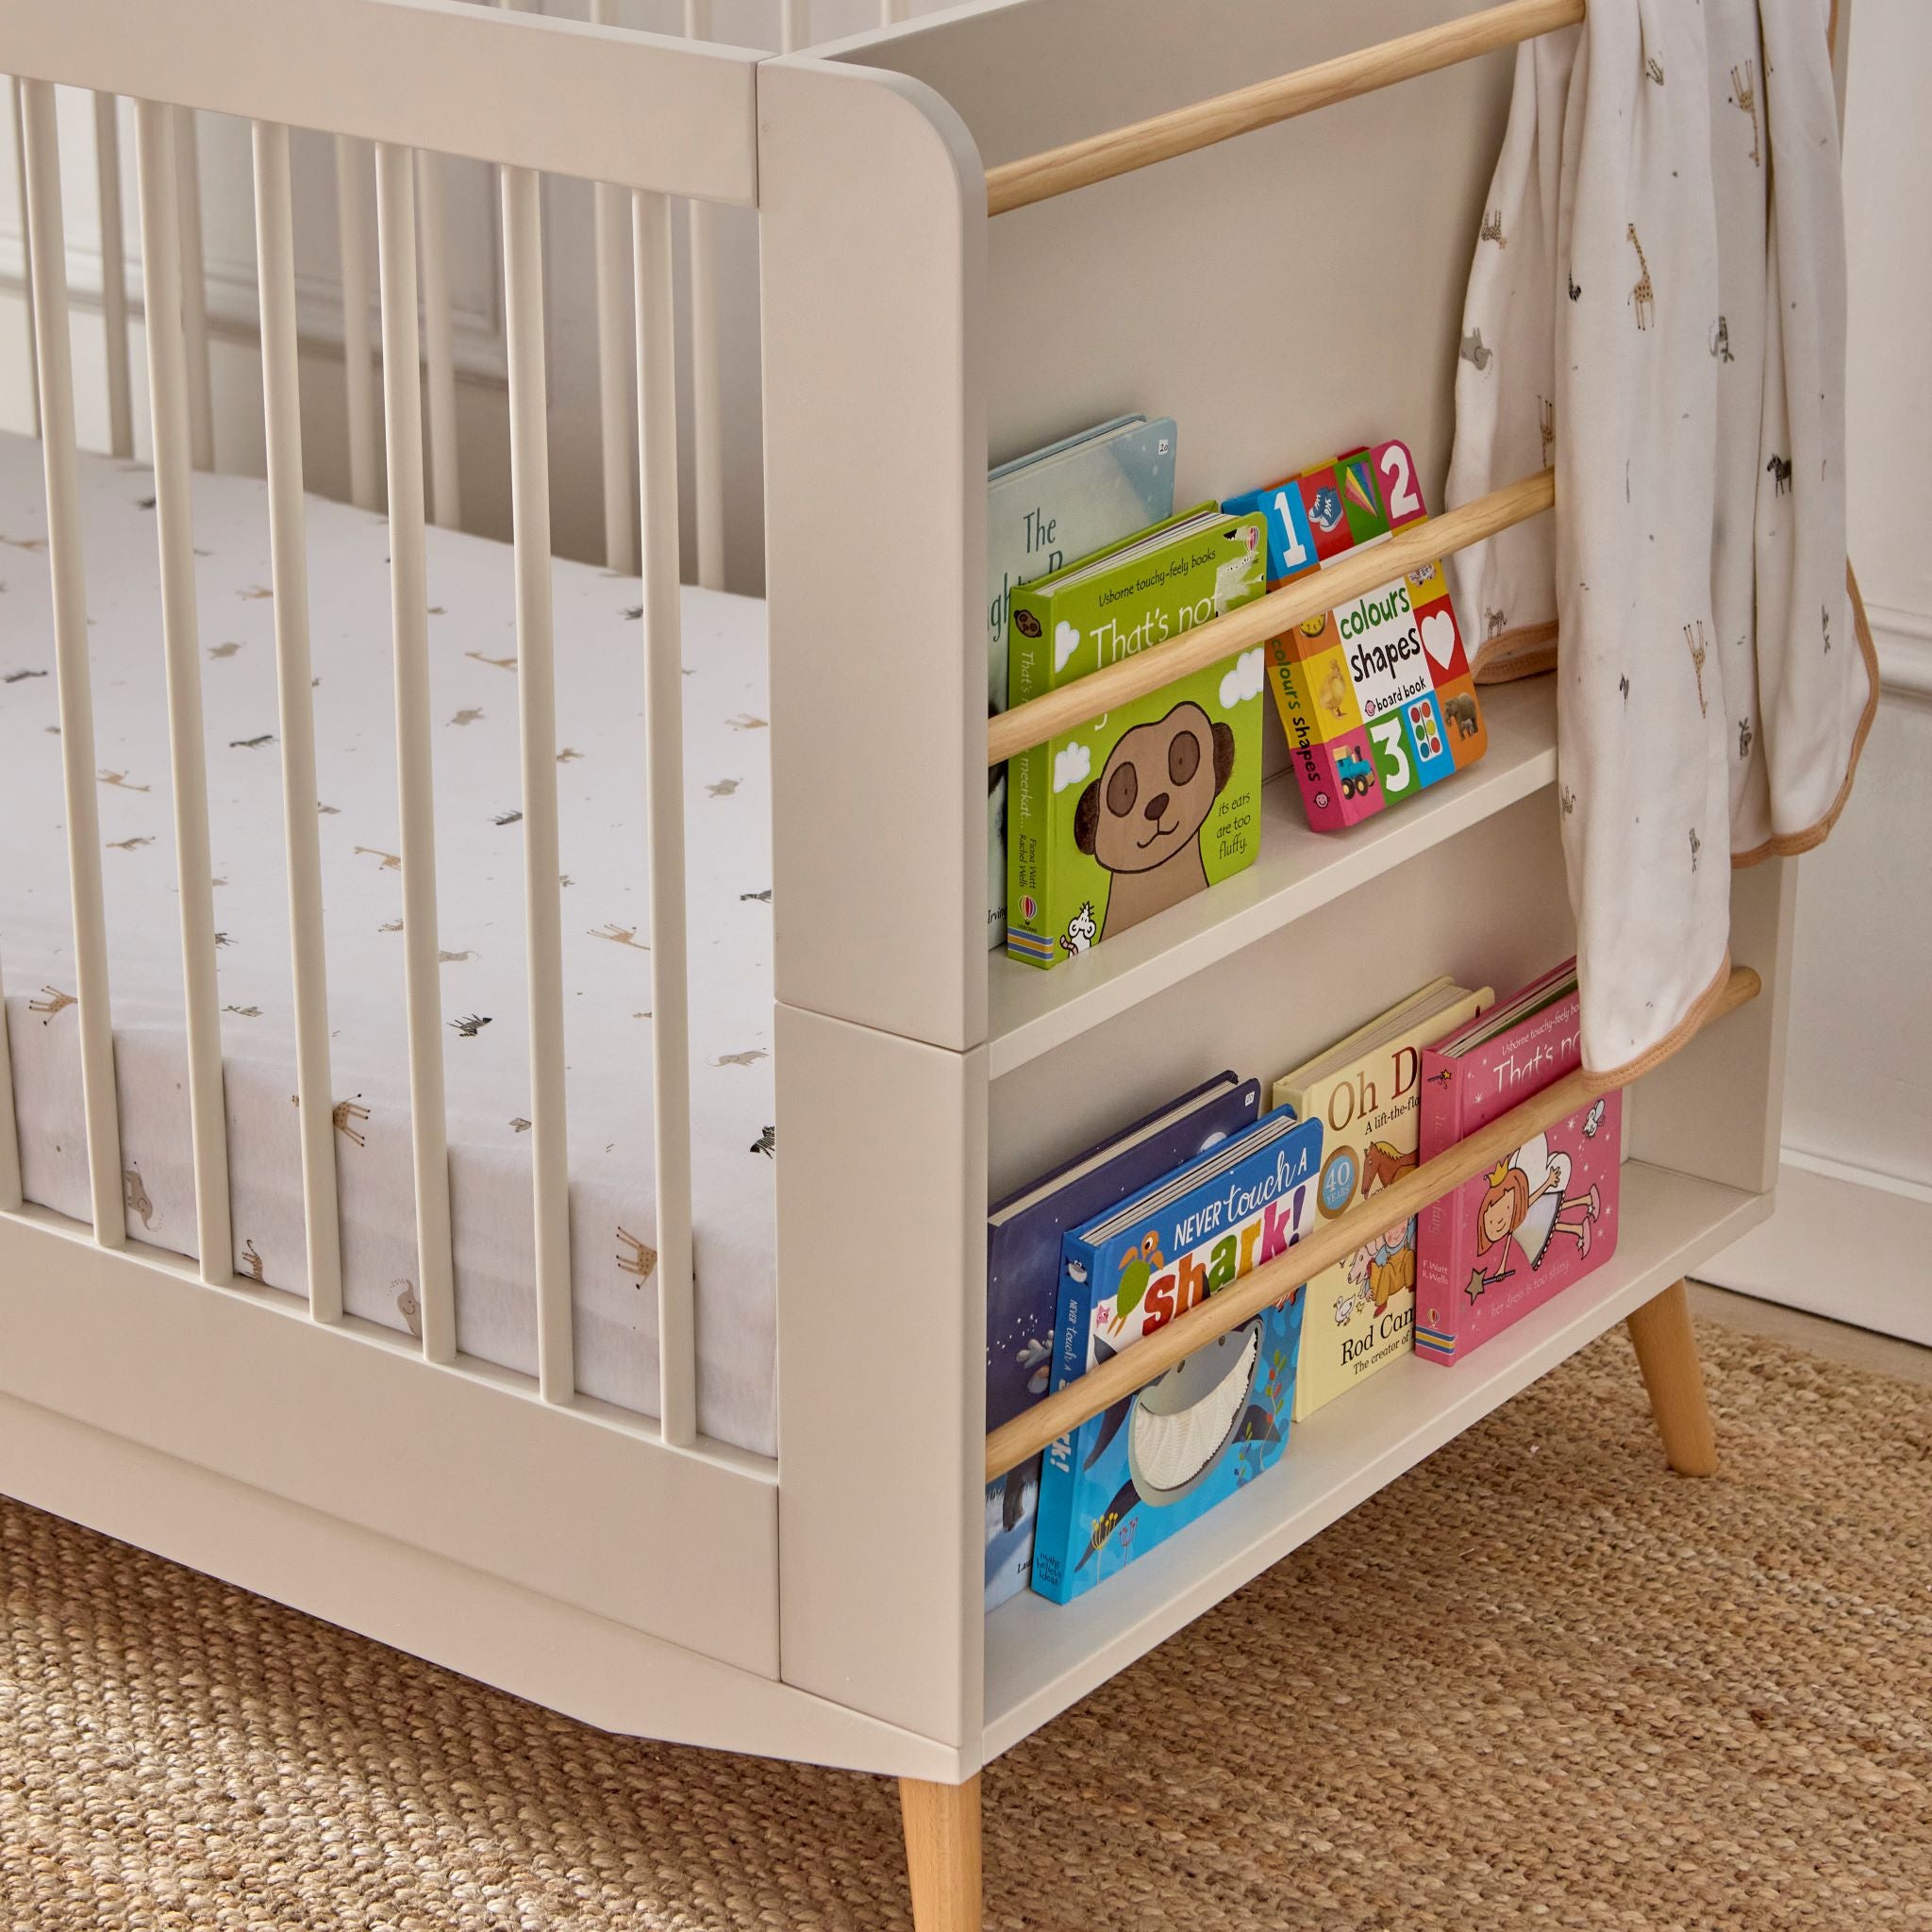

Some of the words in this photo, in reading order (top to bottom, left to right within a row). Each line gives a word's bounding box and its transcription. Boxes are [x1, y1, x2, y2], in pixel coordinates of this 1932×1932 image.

[1274, 491, 1307, 569] 1
[1380, 445, 1420, 520] 2
[1024, 507, 1057, 554] The
[1098, 585, 1134, 608] Usborne
[1136, 558, 1189, 591] touchy-feely
[1191, 547, 1216, 569] books
[1340, 586, 1410, 641] colours
[1090, 608, 1170, 669] That's
[1351, 627, 1422, 682] shapes
[1021, 651, 1035, 694] That's
[1376, 690, 1403, 713] board
[1404, 675, 1426, 699] book
[1271, 640, 1301, 710] colours
[1292, 717, 1321, 782] shapes
[1370, 717, 1410, 792] 3
[1217, 824, 1232, 839] are
[1233, 815, 1251, 830] too
[1218, 802, 1230, 817] its
[1231, 792, 1251, 810] ears
[1493, 1043, 1554, 1094] That's
[1502, 1034, 1529, 1057] Usborne
[1327, 1070, 1379, 1132] Oh
[1364, 1121, 1373, 1136] A
[1174, 1200, 1222, 1251] NEVER
[1221, 1150, 1297, 1223] touch
[1297, 1147, 1307, 1175] A
[1325, 1161, 1350, 1193] 40
[1326, 1179, 1351, 1205] YEARS
[1141, 1185, 1307, 1337] shark!
[1068, 1299, 1078, 1324] NEVER
[1064, 1326, 1077, 1360] touch
[1341, 1324, 1374, 1367] Rod
[1353, 1359, 1369, 1375] The
[1371, 1340, 1400, 1364] creator
[1401, 1329, 1411, 1344] of
